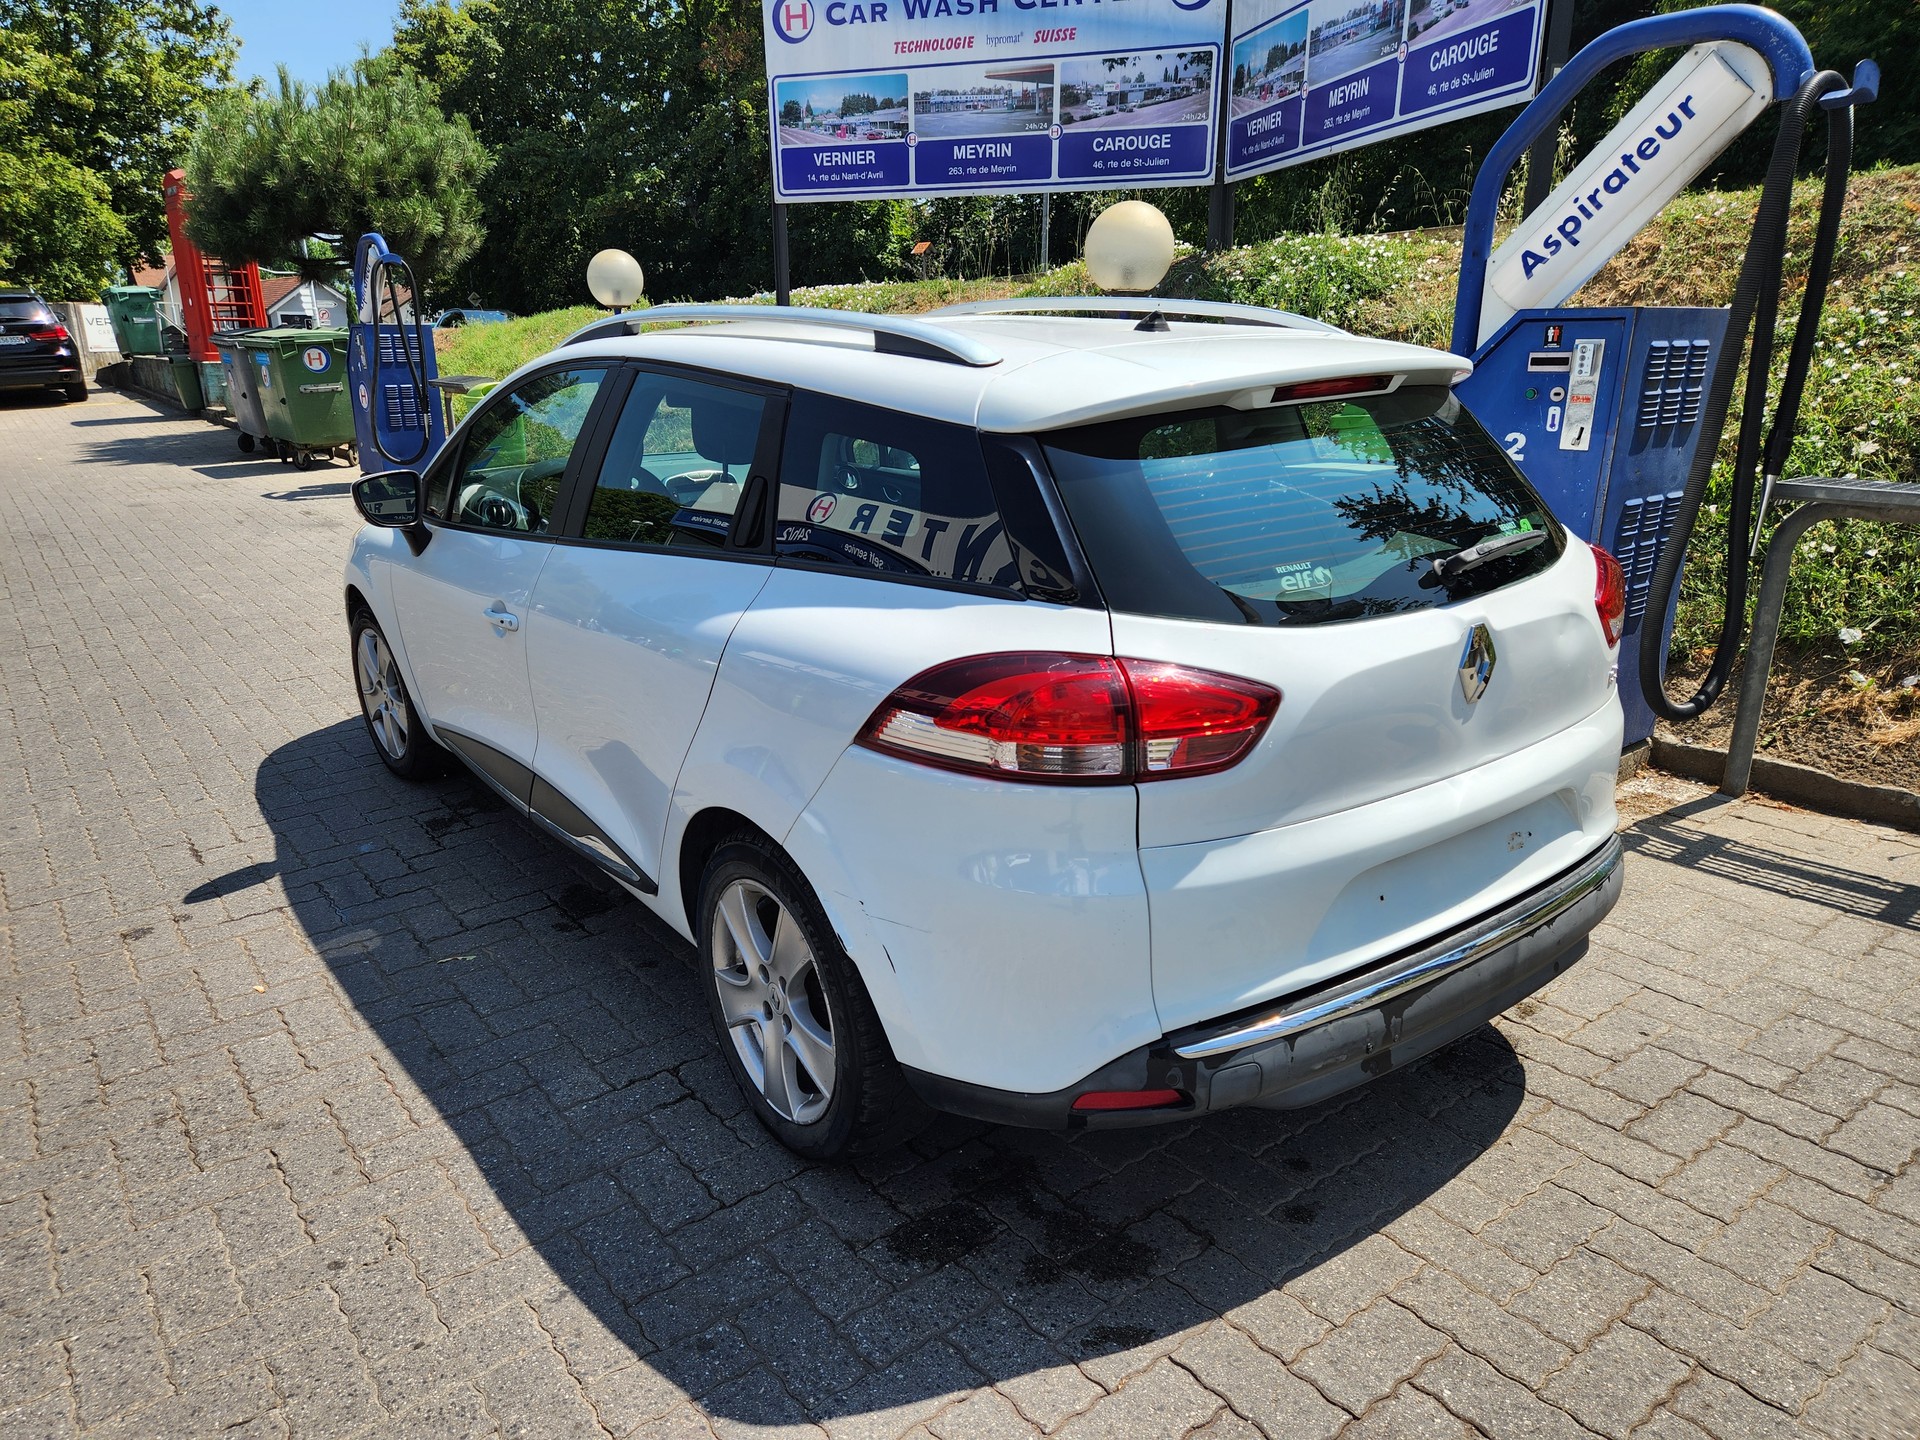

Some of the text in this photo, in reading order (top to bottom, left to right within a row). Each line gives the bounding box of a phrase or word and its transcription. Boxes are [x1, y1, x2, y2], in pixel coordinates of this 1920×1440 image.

[784, 3, 809, 32] H
[826, 2, 888, 26] CAR
[904, 0, 998, 20] WASH
[893, 36, 975, 54] TECHNOLOGIE
[1033, 27, 1077, 44] SUISSE
[1429, 30, 1500, 72] CAROUGE
[1427, 67, 1495, 97] 46, rte de St-Julien
[1328, 77, 1370, 108] MEYRIN
[1181, 112, 1206, 121] 24h/24
[1246, 111, 1282, 137] VERNIER
[1335, 115, 1343, 125] rte
[1343, 112, 1351, 122] de
[1351, 105, 1370, 122] Meyrin
[1025, 122, 1048, 130] 24h/24
[953, 143, 1012, 160] MEYRIN
[1092, 134, 1171, 152] CAROUGE
[813, 150, 876, 166] VERNIER
[1092, 157, 1169, 170] 46, rte de St-Julien
[807, 171, 884, 182] 14, rte du Nant-d'Avril
[948, 164, 1017, 176] 263, rte de Meyrin
[1520, 94, 1695, 280] Aspirateur
[307, 352, 324, 367] H
[1504, 432, 1527, 462] 2
[1275, 562, 1312, 574] RENAULT
[1281, 570, 1313, 591] elf
